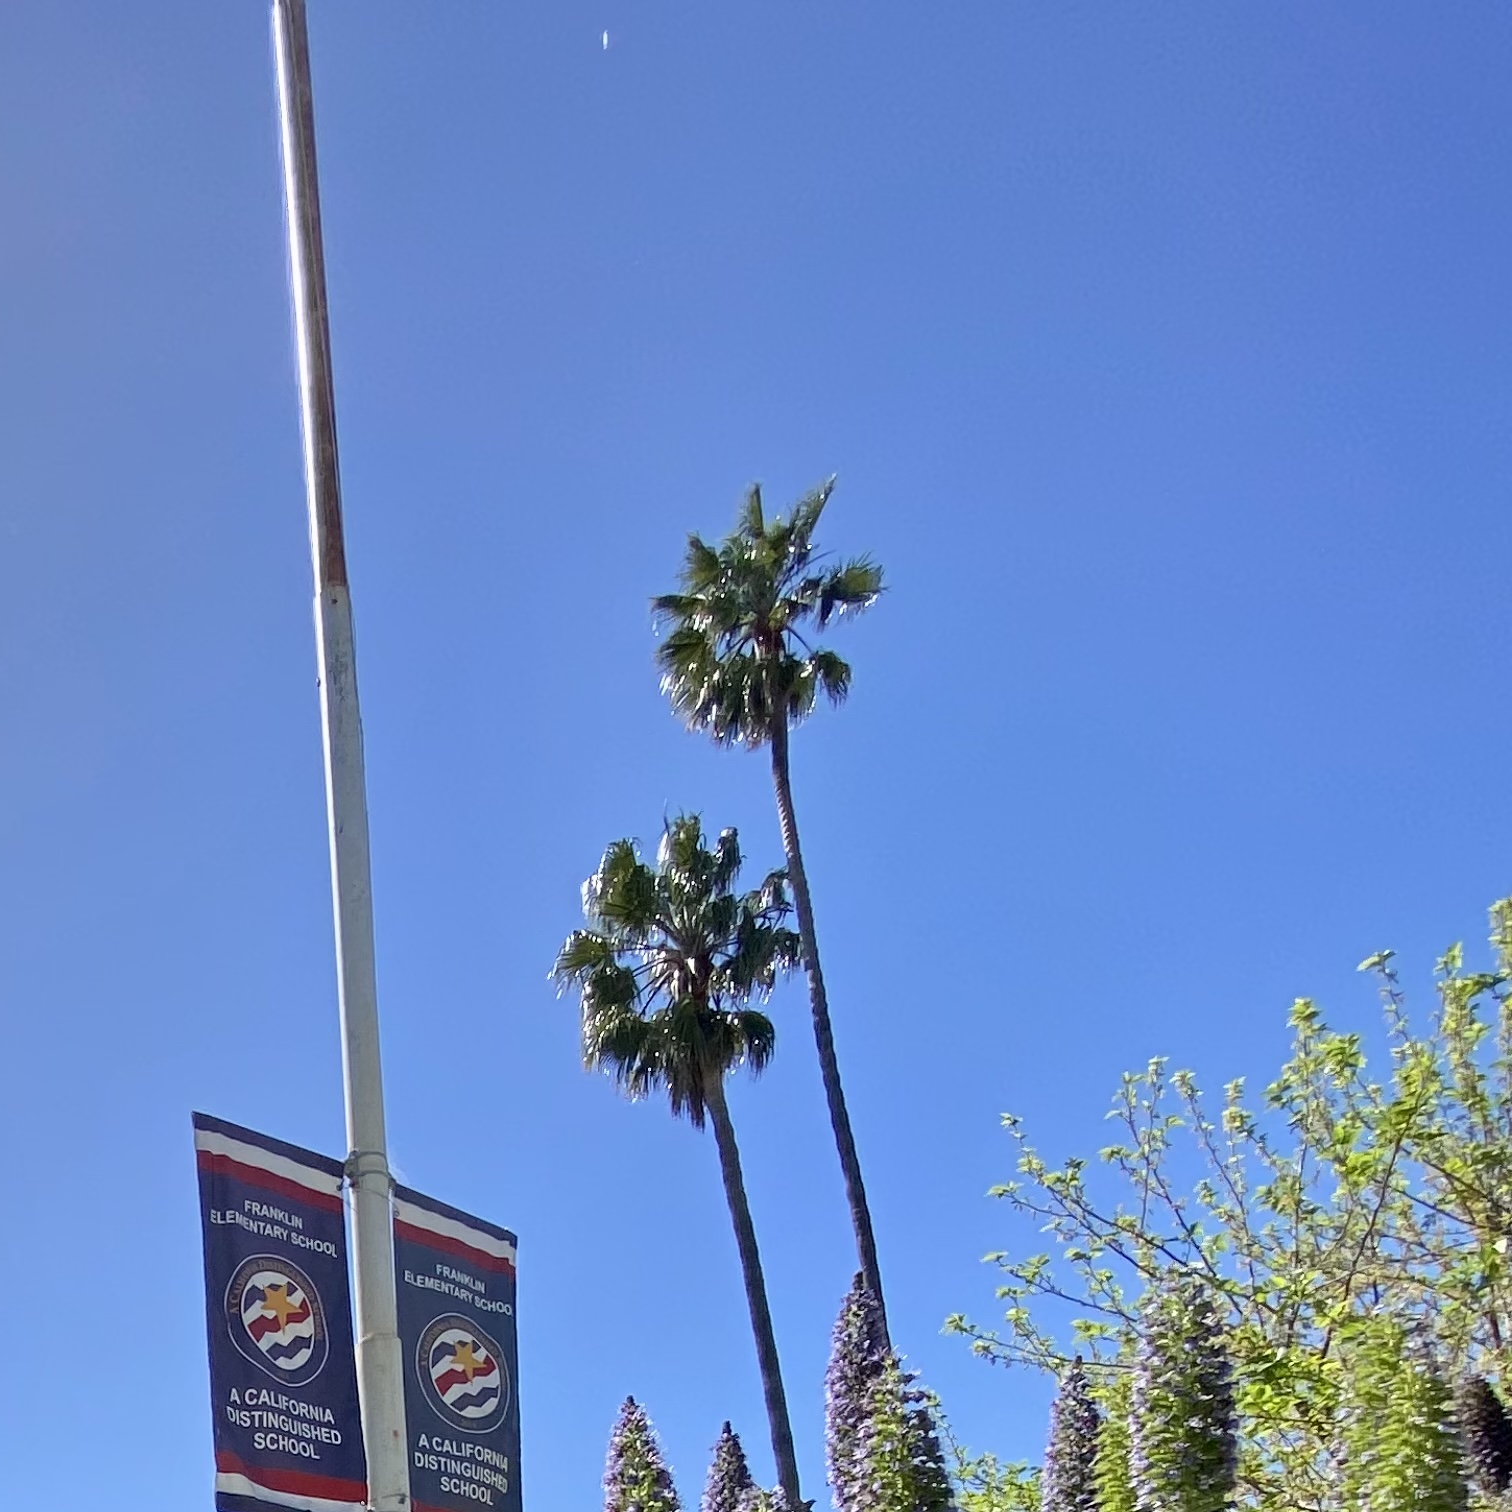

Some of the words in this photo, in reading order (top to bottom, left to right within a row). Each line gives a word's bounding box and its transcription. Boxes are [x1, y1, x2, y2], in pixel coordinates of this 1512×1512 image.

[210, 1209, 288, 1241] ELEMENTARY
[291, 1232, 337, 1258] SCHOOL
[244, 1200, 303, 1229] FRANKLIN
[404, 1270, 473, 1303] ELEMENTARY
[475, 1296, 513, 1316] SCHOO
[436, 1264, 485, 1294] FRANKLIN
[226, 1405, 342, 1445] DISTINGUISHED
[229, 1387, 241, 1405] A
[244, 1388, 335, 1425] CALIFORNIA
[253, 1432, 320, 1460] SCHOOL
[418, 1433, 430, 1449] A
[432, 1436, 508, 1472] CALIFORNIA
[414, 1451, 508, 1494] DISTINGUISHED
[440, 1476, 494, 1506] SCHOOL
